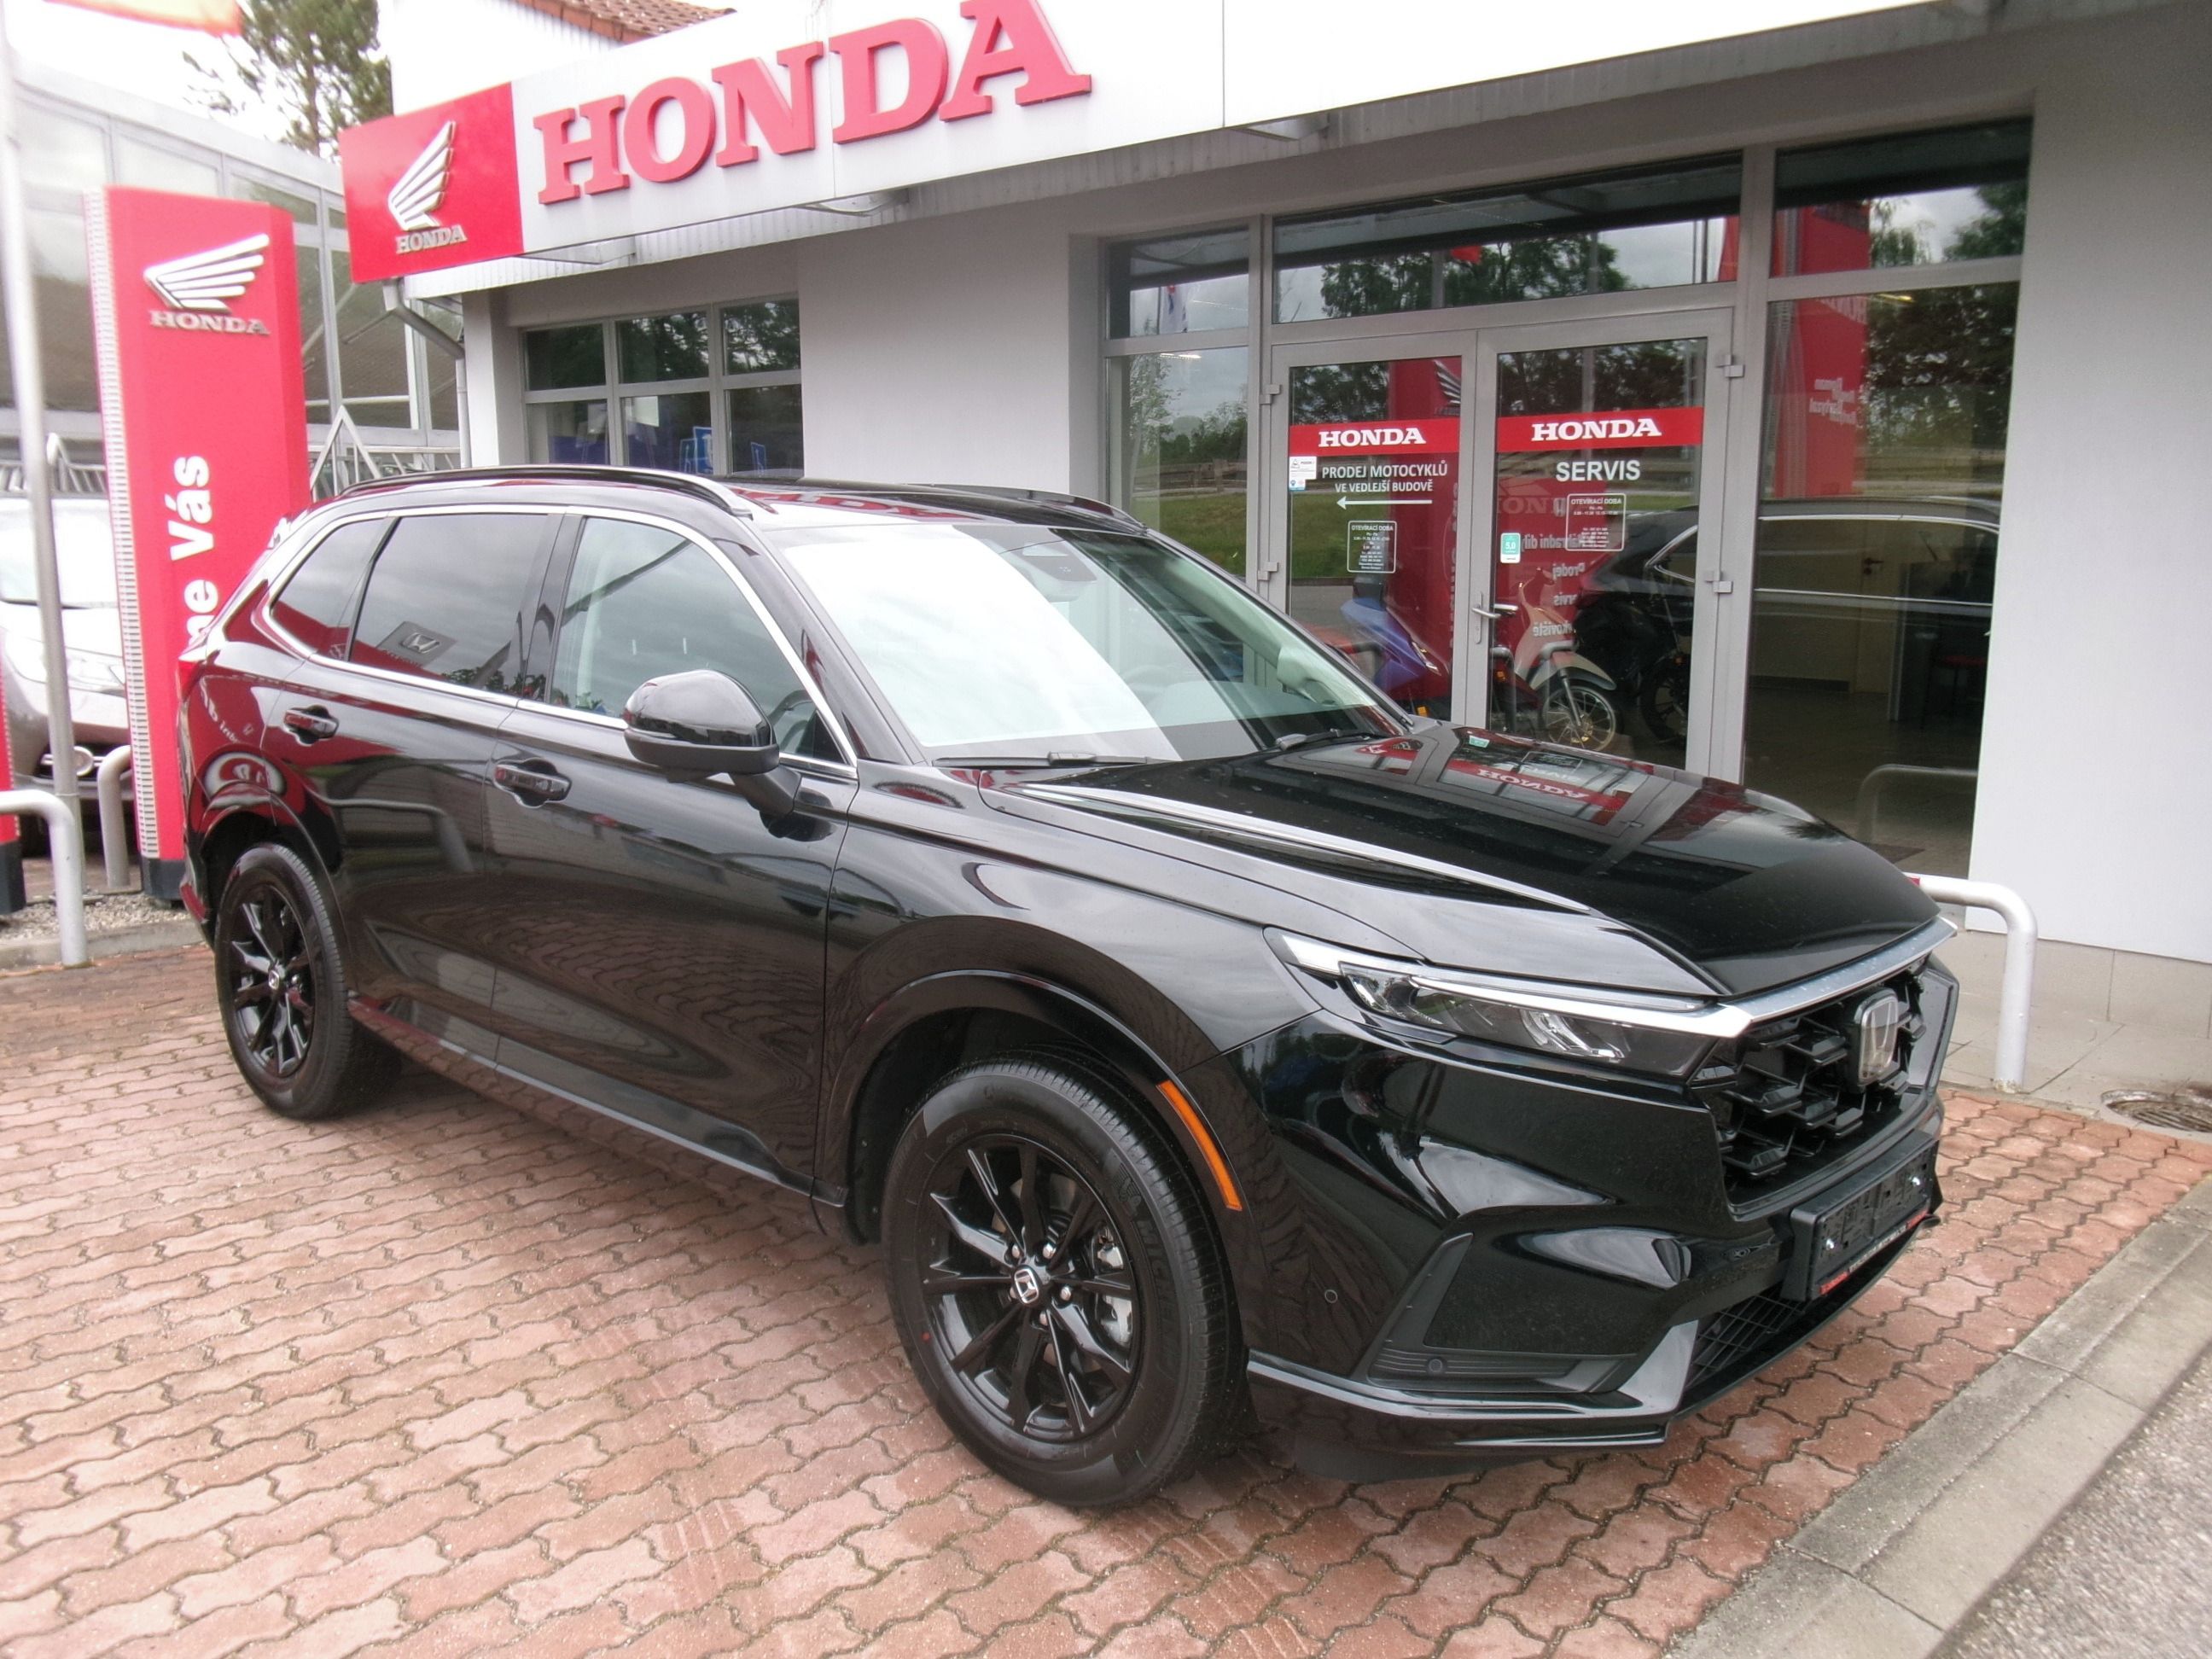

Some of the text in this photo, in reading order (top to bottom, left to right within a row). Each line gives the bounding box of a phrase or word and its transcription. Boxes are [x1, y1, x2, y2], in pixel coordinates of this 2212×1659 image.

[533, 0, 1091, 205] HONDA
[395, 224, 468, 255] HONDA
[149, 310, 271, 336] HONDA
[1318, 428, 1427, 447] HONDA
[1531, 418, 1662, 441] HONDA
[1322, 466, 1366, 479] PRODEJ
[1370, 460, 1448, 478] MOTOCYKLŮ
[1556, 460, 1641, 482] SERVIS
[1335, 479, 1434, 492] VE VEDLEJŠÍ BUDOVĚ
[164, 456, 215, 561] Vás
